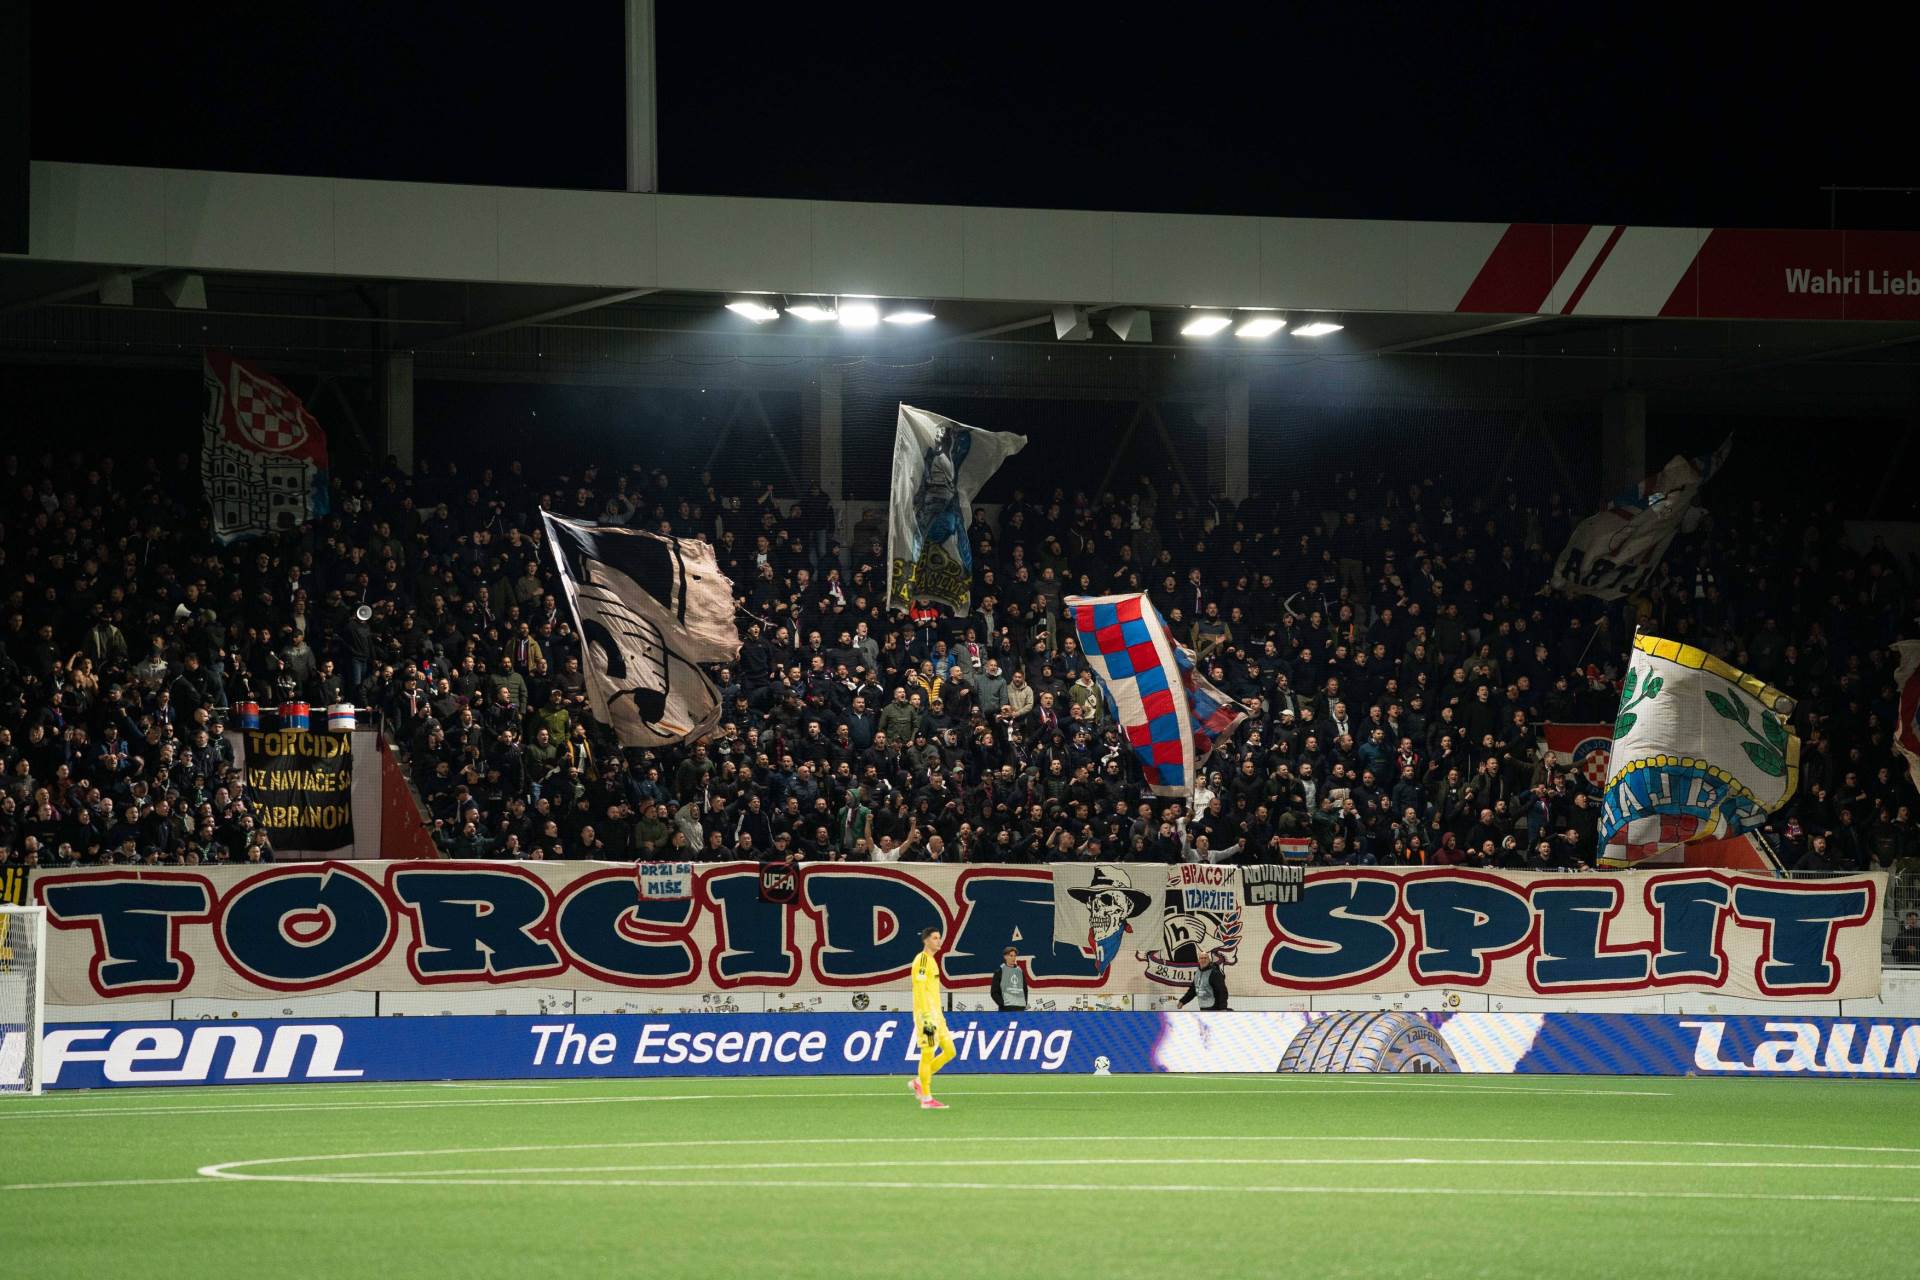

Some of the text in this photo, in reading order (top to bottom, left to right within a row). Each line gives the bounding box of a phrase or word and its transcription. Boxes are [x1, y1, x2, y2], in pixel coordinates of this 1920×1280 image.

[1785, 268, 1860, 294] Wahri
[248, 731, 350, 759] TORCIDA
[0, 867, 23, 906] li
[763, 872, 795, 891] UEFA
[1181, 864, 1223, 885] BRACO
[35, 861, 1112, 998] TORCIDA
[1261, 867, 1876, 998] SPLIT
[1155, 964, 1197, 981] 28.10.1
[530, 1024, 617, 1065] The
[633, 1023, 827, 1064] Essence
[843, 1021, 897, 1062] of
